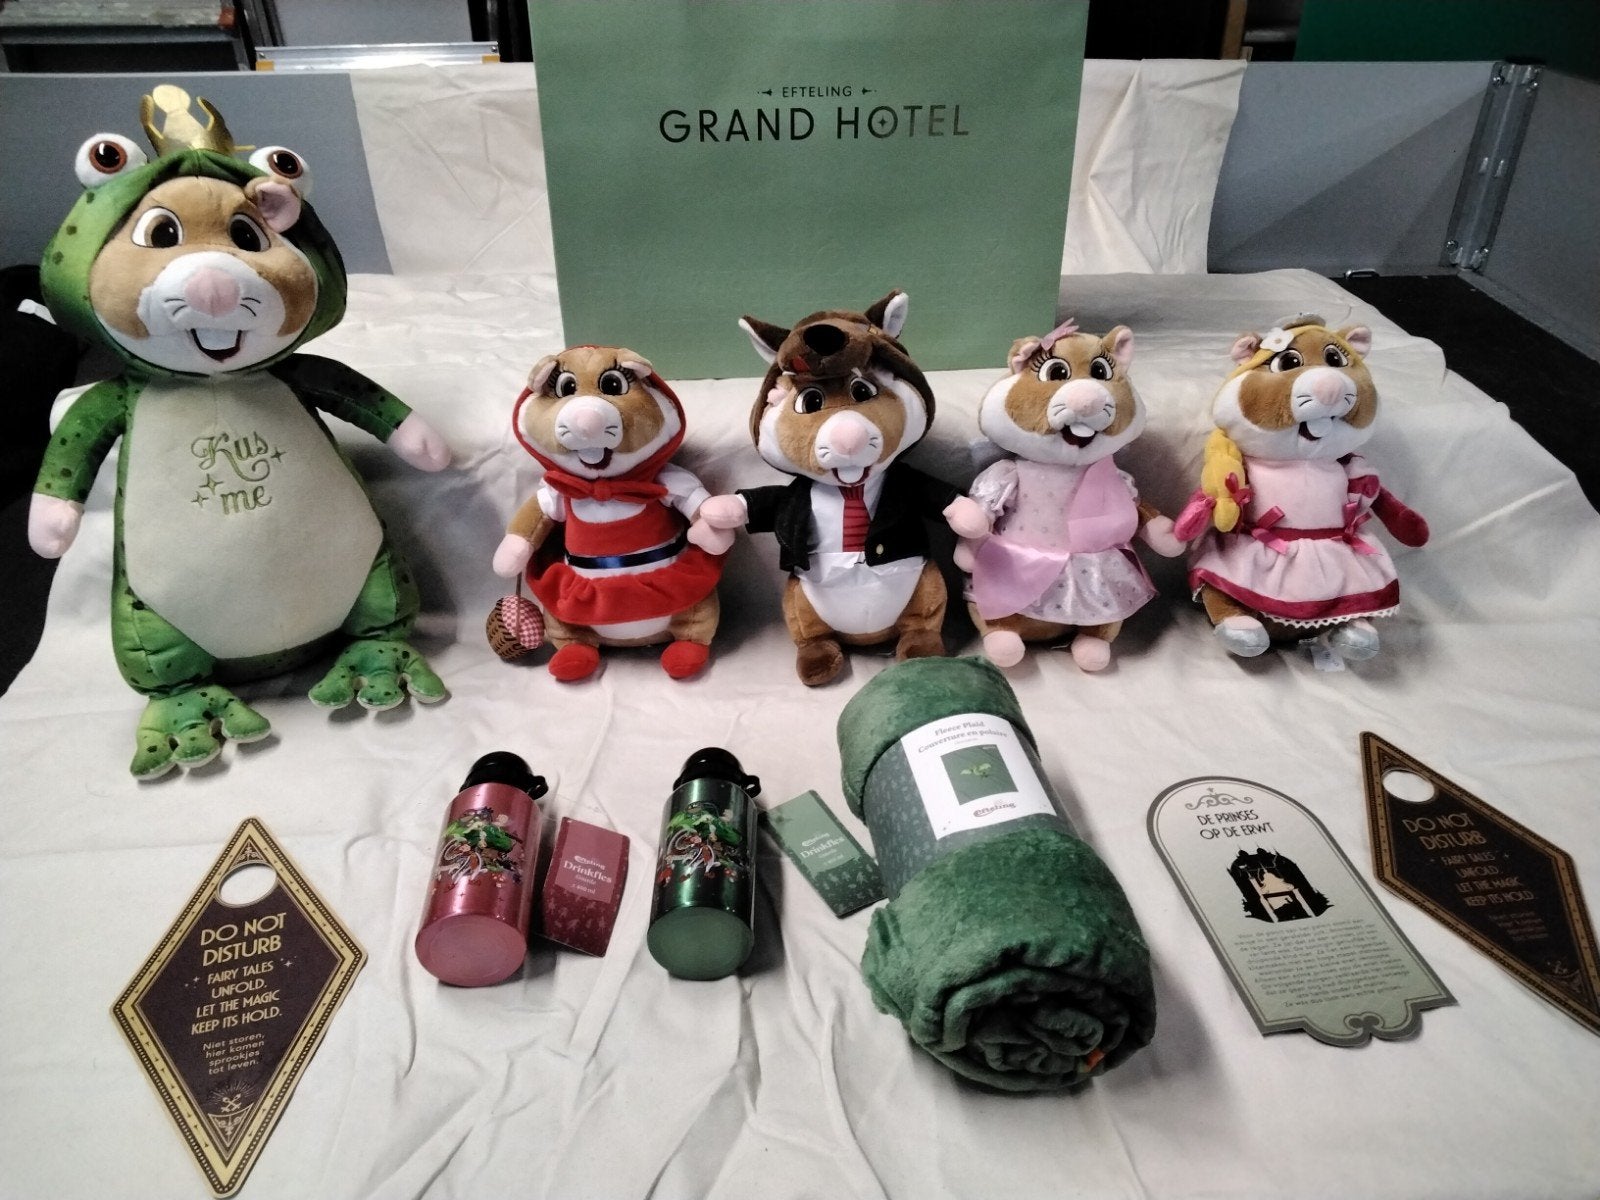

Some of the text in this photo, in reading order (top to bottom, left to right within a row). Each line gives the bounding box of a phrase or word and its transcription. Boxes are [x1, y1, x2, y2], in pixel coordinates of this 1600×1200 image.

[782, 86, 852, 98] EFTELING
[659, 104, 969, 143] GRAND HOTEL
[191, 431, 270, 482] Kus
[220, 486, 272, 515] me
[934, 724, 961, 736] Fleece
[918, 733, 966, 753] Couverture
[1197, 809, 1259, 826] DE PRINSES
[1402, 813, 1474, 833] DO NOT
[1200, 822, 1274, 840] OP DE ERWT
[1419, 830, 1487, 850] DISTURB
[200, 912, 287, 946] DO NOT
[202, 935, 282, 967] DISTURB
[207, 960, 274, 985] FAIRY TALES
[211, 978, 268, 999] UNFOLD.
[196, 990, 281, 1019] LET THE MAGIC
[191, 1006, 283, 1036] KEEP ITS HOLD.
[202, 1041, 226, 1051] Niet
[205, 1041, 265, 1060] hier komen
[208, 1050, 261, 1070] sprookjes
[208, 1066, 225, 1076] tot
